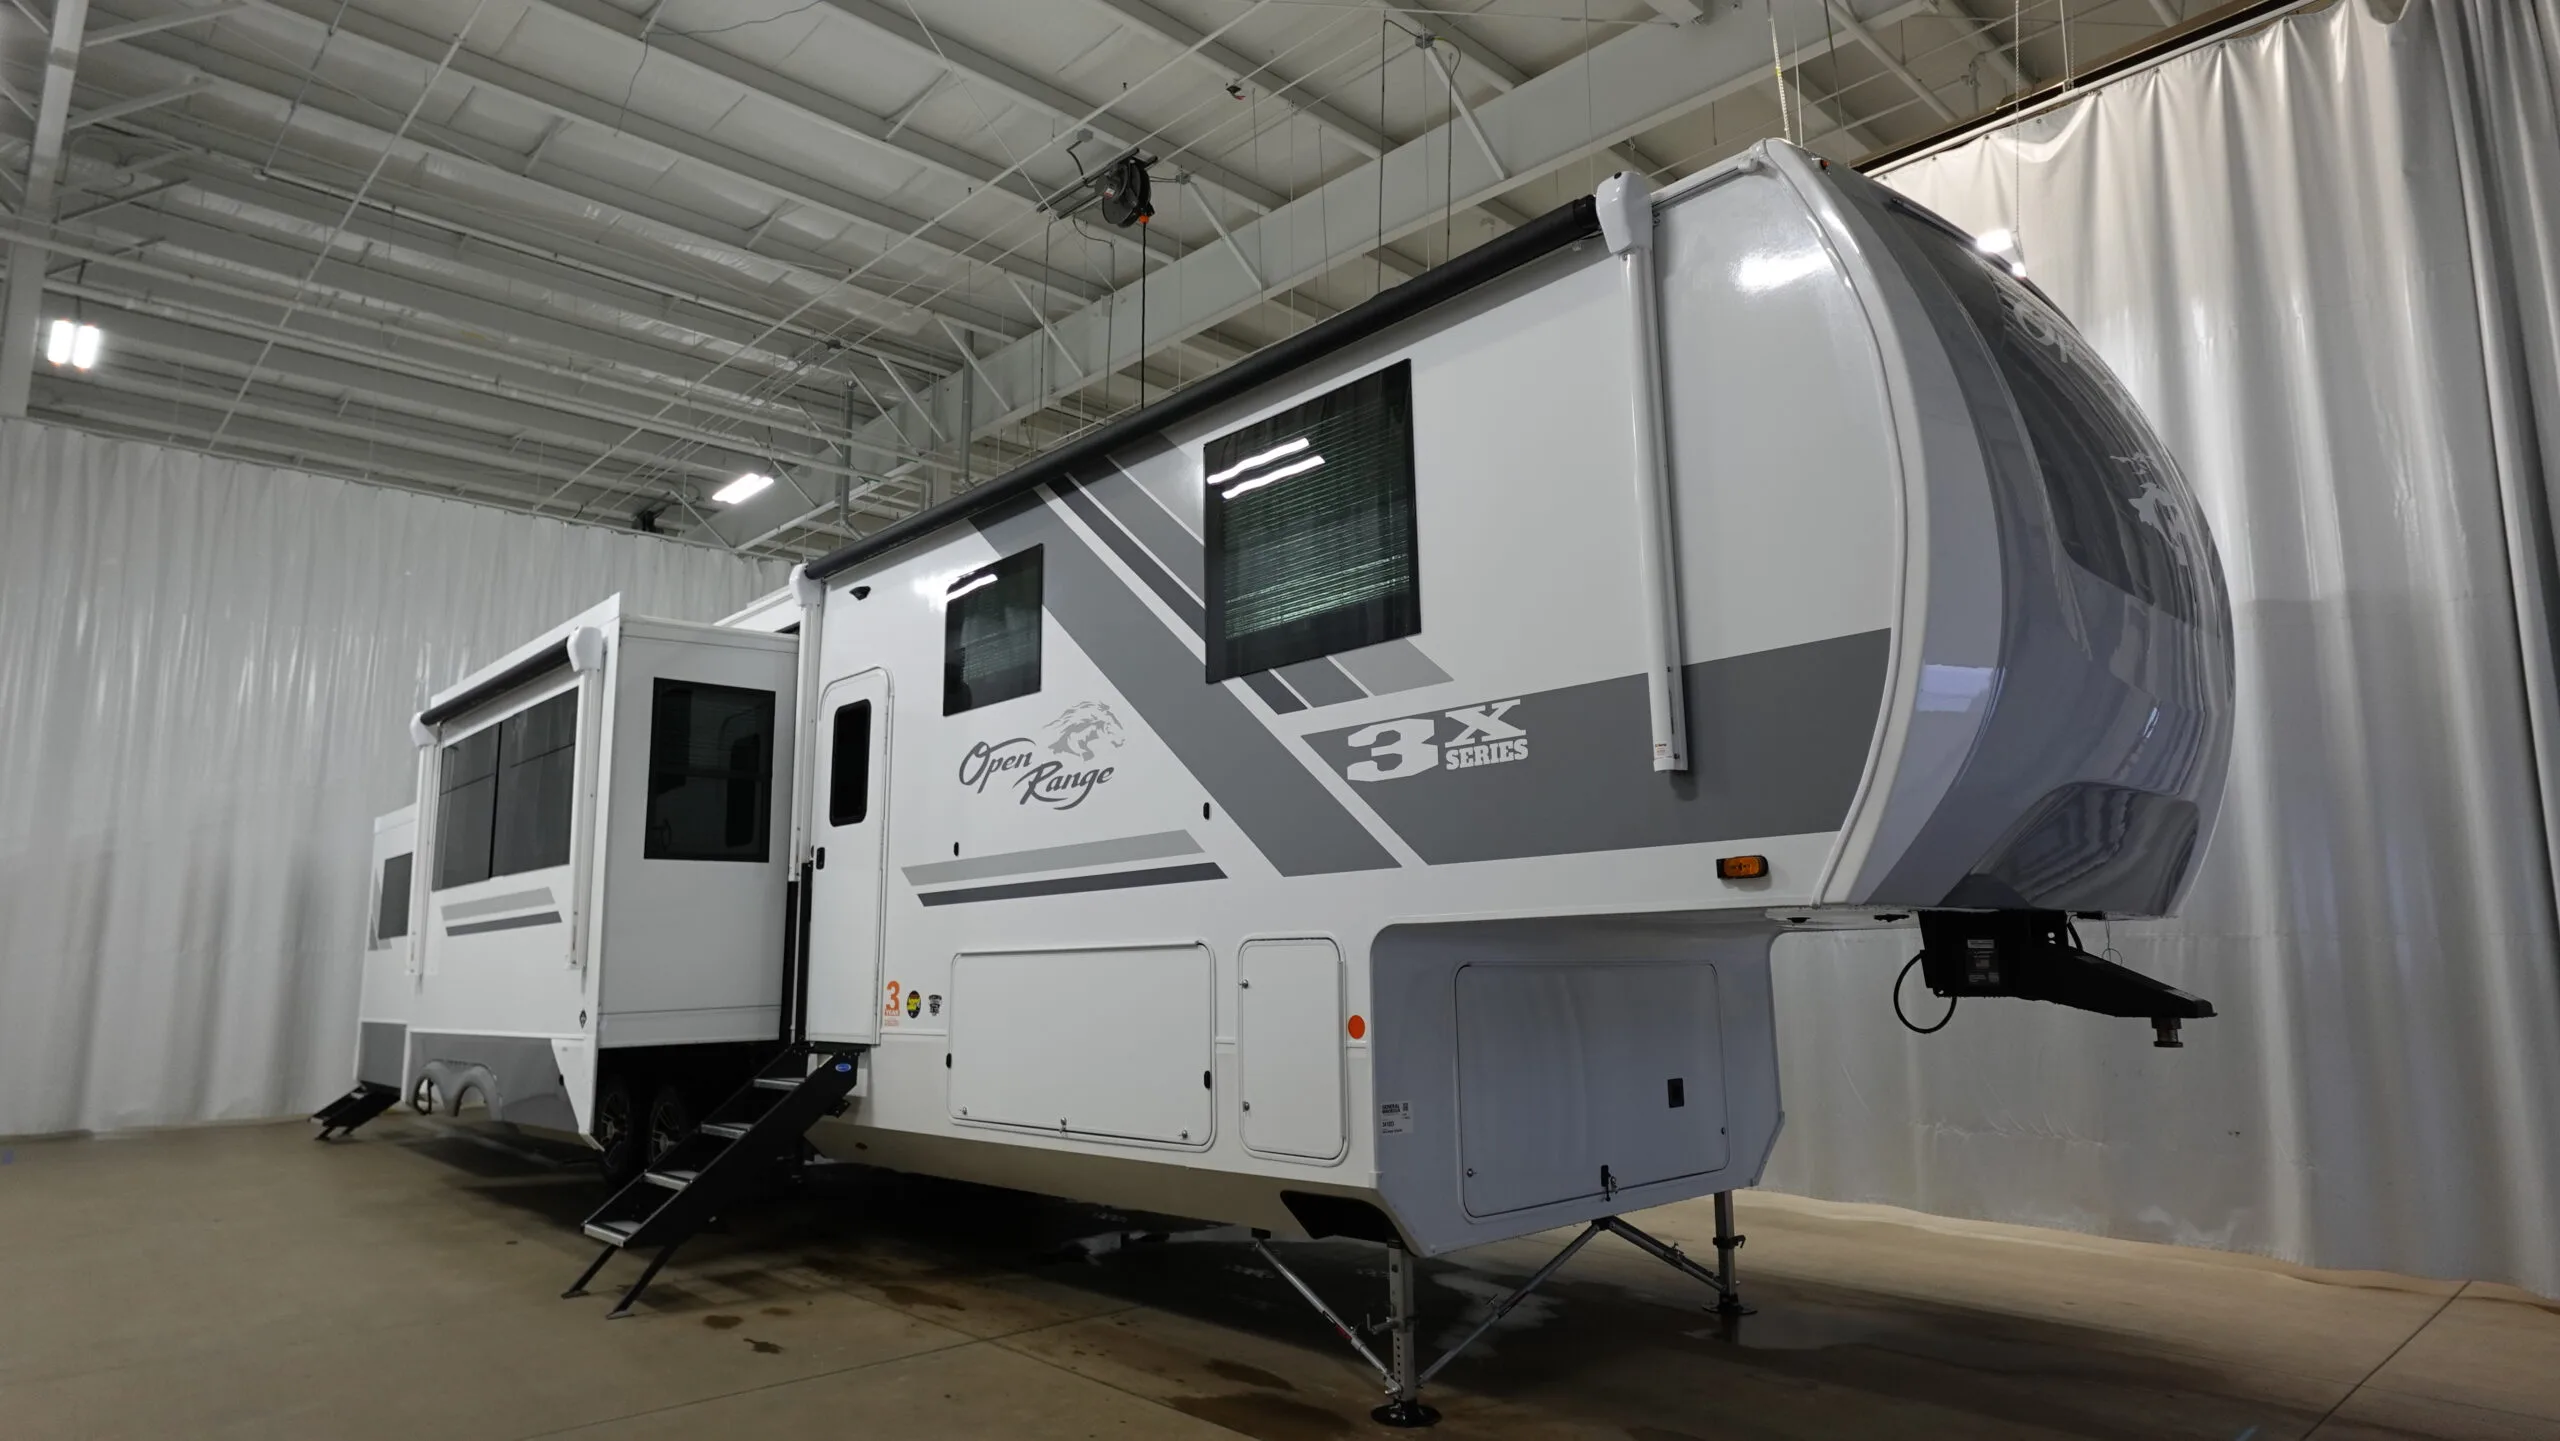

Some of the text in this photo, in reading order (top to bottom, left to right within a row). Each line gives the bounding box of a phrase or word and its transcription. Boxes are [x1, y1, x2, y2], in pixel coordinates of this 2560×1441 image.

[959, 737, 1037, 794] Open
[1445, 738, 1529, 771] SERIES
[1012, 760, 1115, 811] Range
[885, 980, 900, 1011] 3
